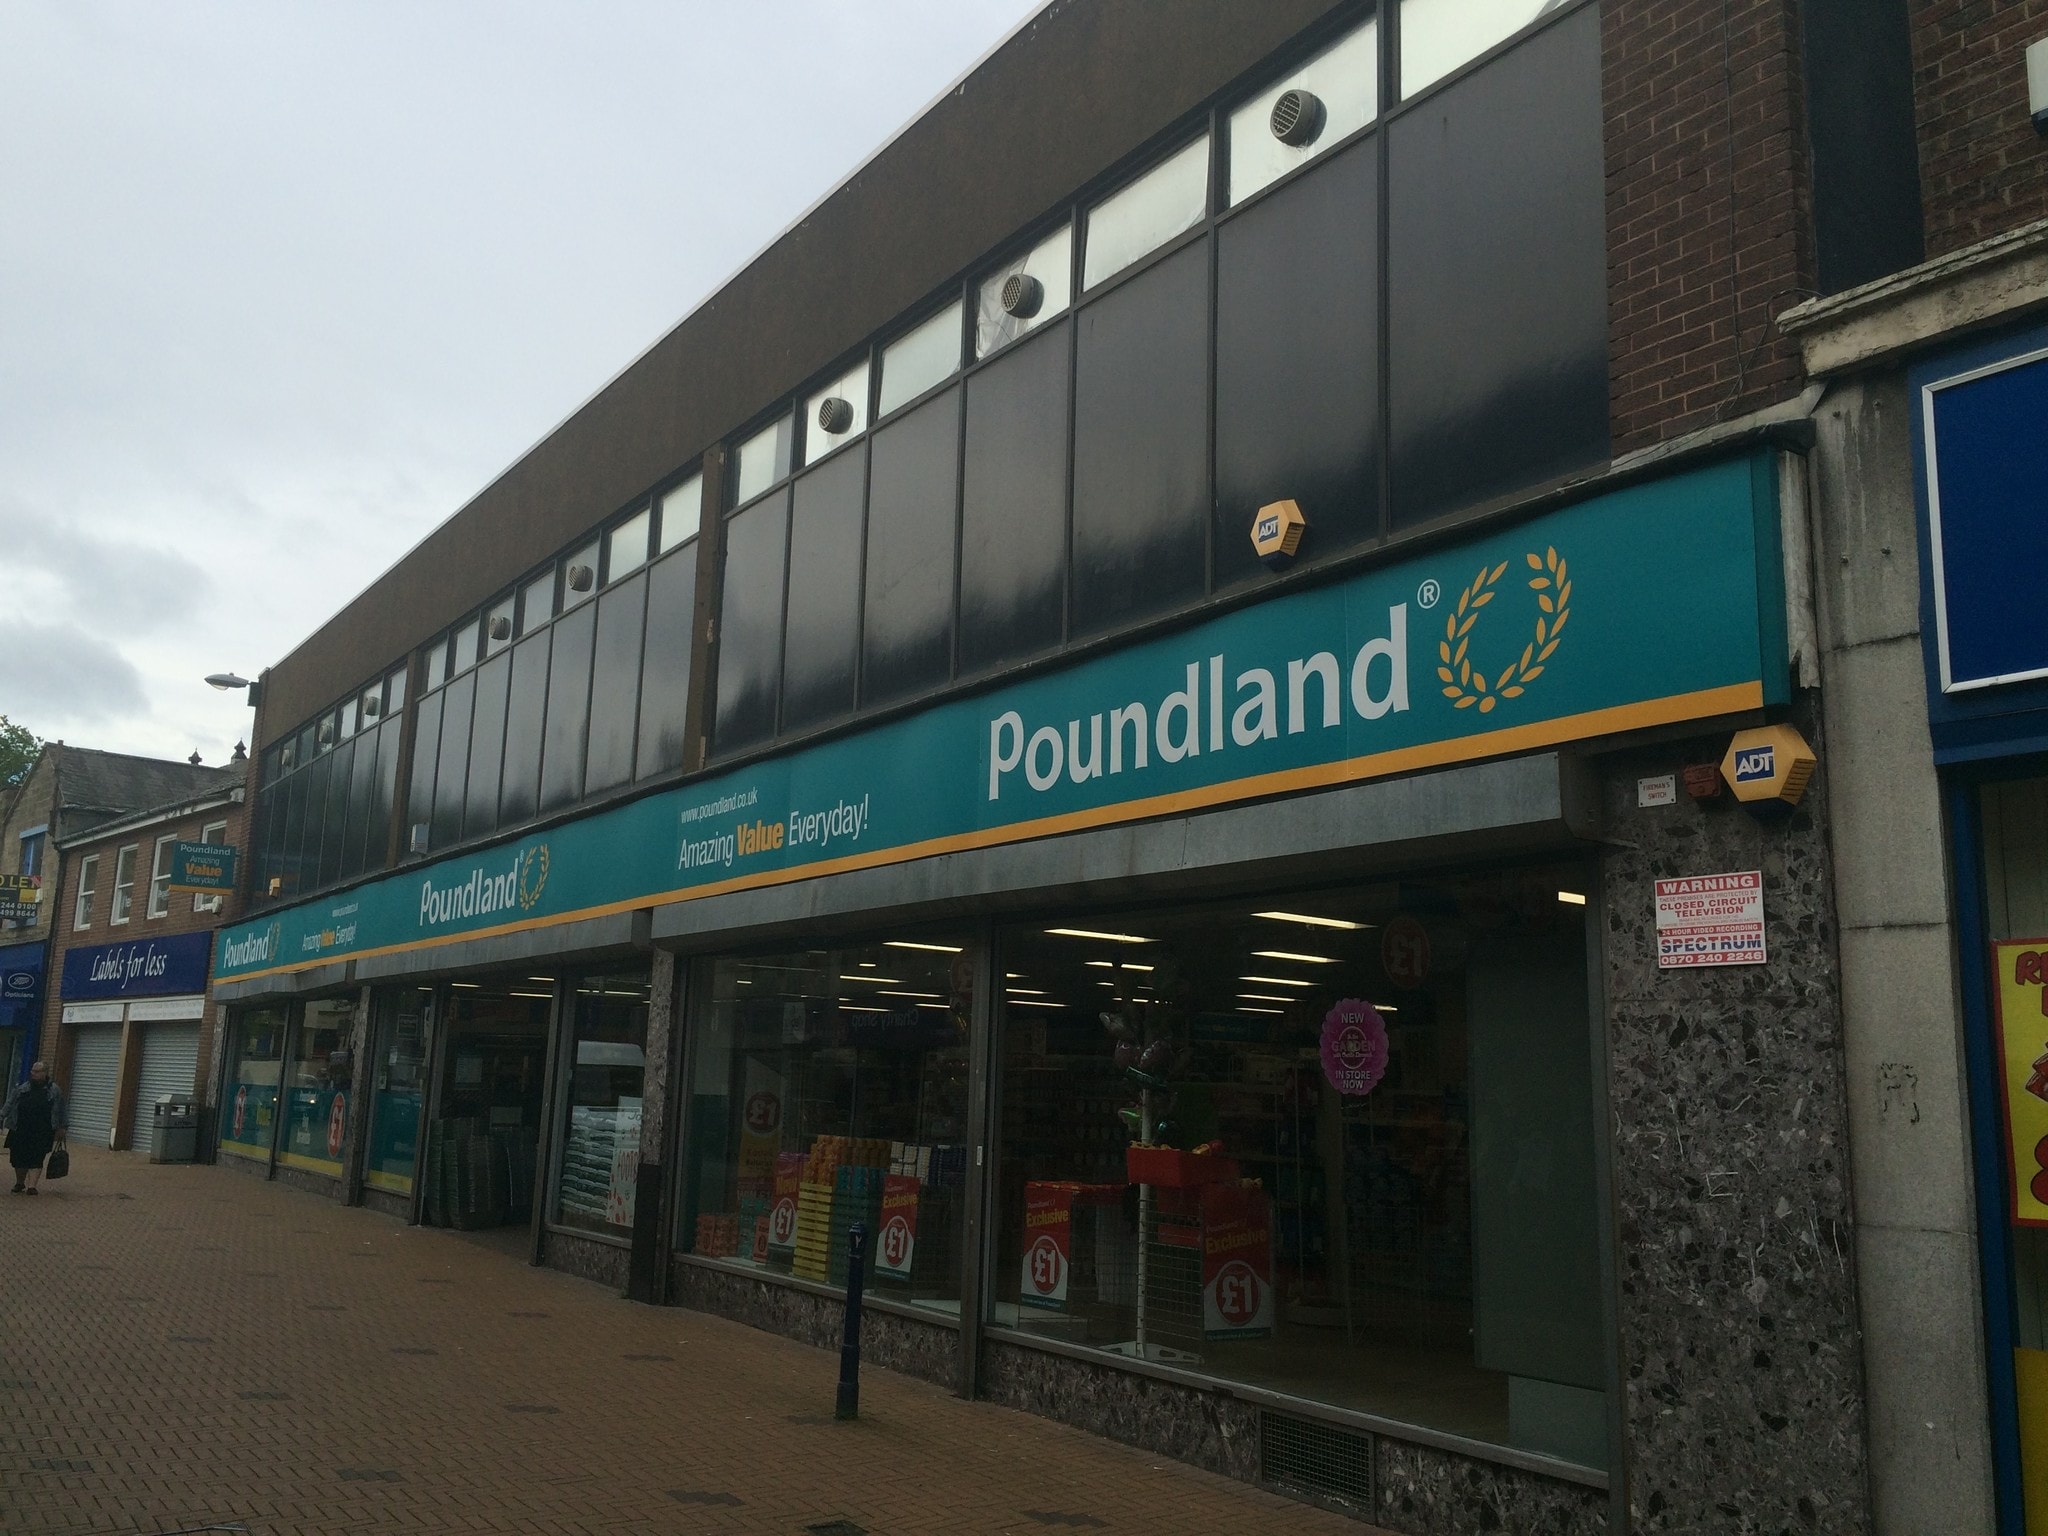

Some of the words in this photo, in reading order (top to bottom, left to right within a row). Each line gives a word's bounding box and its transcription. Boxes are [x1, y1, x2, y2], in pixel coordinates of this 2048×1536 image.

[1258, 520, 1278, 539] ADT
[989, 602, 1410, 801] Poundland
[1736, 752, 1773, 775] ADT
[680, 786, 758, 824] www.poundland.co.uk
[678, 831, 735, 870] Amazing
[736, 820, 785, 856] Value
[788, 793, 869, 847] Everyday!
[180, 843, 231, 856] Poundland
[185, 863, 222, 877] Value
[189, 855, 220, 866] Amazing
[419, 857, 519, 926] Poundland
[1662, 875, 1754, 894] WARNING
[1660, 900, 1705, 911] CLOSED
[1709, 896, 1758, 907] CIRCUIT
[1675, 906, 1744, 918] TELEVISION
[1672, 927, 1692, 935] HOUR
[1693, 926, 1714, 934] VIDEO
[1716, 923, 1759, 932] RECORDING
[223, 928, 271, 968] Poundland
[1661, 933, 1761, 953] SPECTRUM
[90, 948, 124, 981] Labels
[120, 945, 145, 989] for
[144, 943, 168, 976] less
[1661, 955, 1694, 964] 0870
[1697, 953, 1723, 963] 240
[1726, 951, 1763, 961] 2246
[1341, 1012, 1365, 1023] NEW
[1335, 1070, 1344, 1079] IN
[1345, 1070, 1371, 1080] STORE
[1342, 1080, 1364, 1089] NOW
[883, 1192, 918, 1209] Exclusive
[776, 1207, 793, 1235] £1
[1026, 1208, 1069, 1228] Exclusive
[886, 1226, 906, 1259] £1
[1206, 1229, 1267, 1255] Exclusive
[1034, 1248, 1056, 1284] £1
[1222, 1274, 1253, 1314] £1
